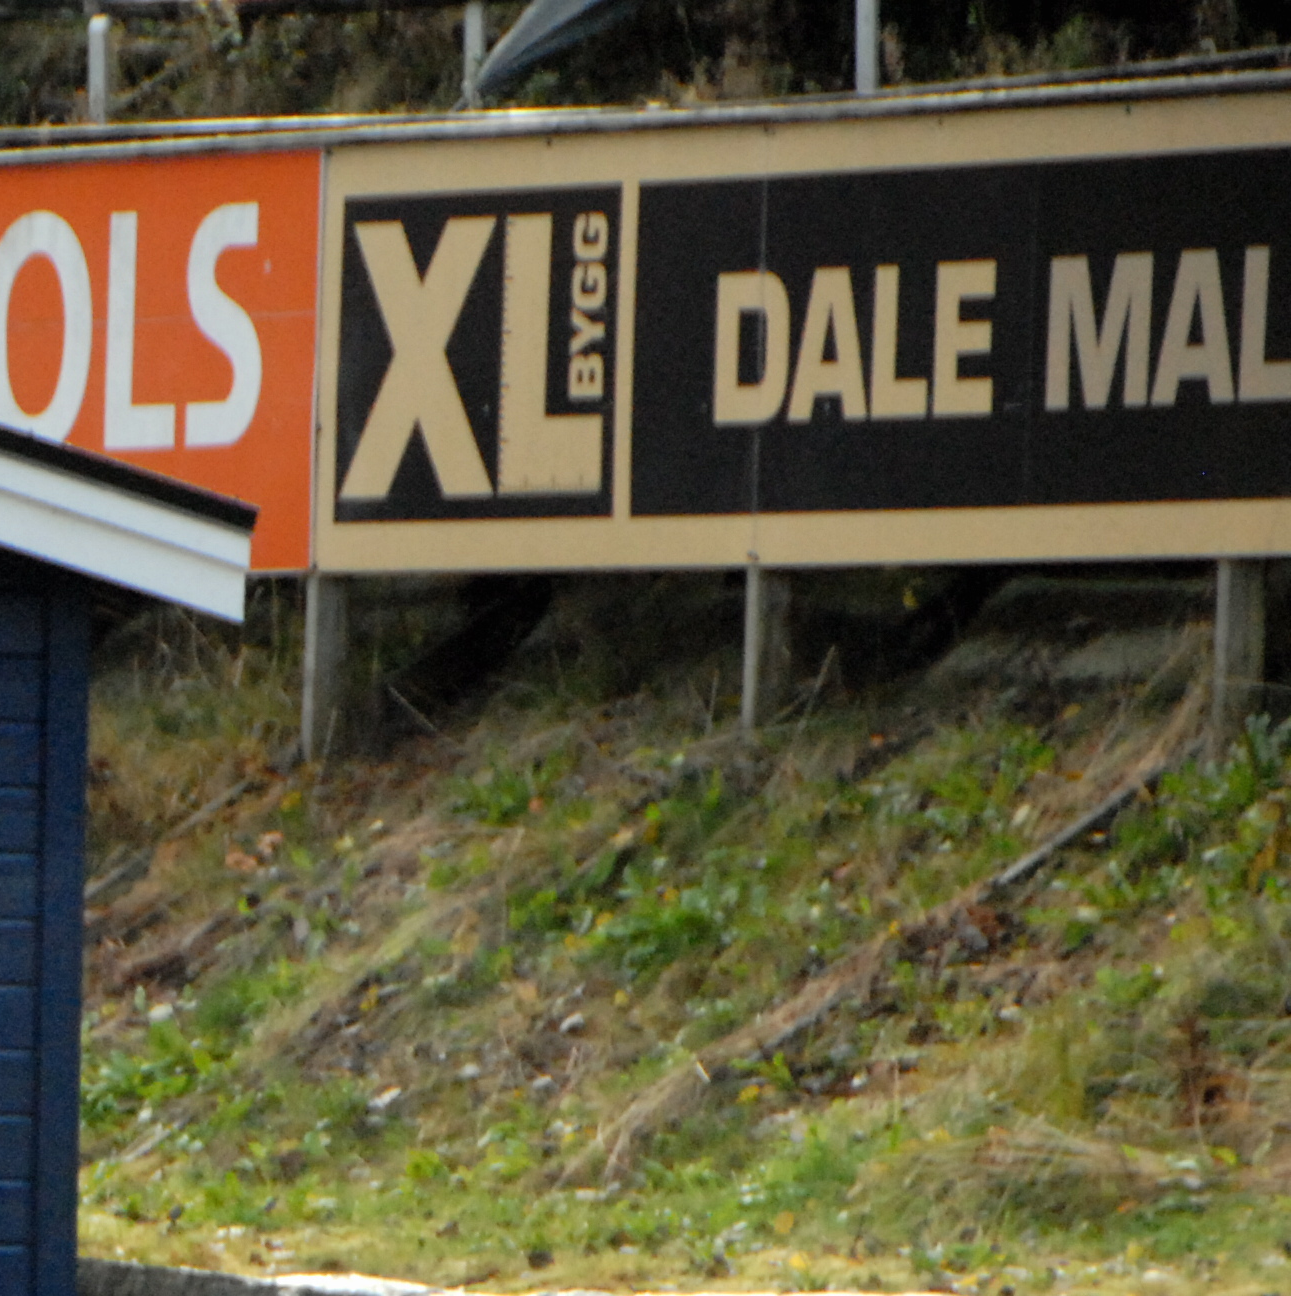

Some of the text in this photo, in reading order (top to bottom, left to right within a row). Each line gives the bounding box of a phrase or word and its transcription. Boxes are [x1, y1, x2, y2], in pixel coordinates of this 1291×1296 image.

[337, 212, 603, 502] XL
[567, 210, 610, 401] BYGG
[712, 244, 1291, 428] DALE MAL
